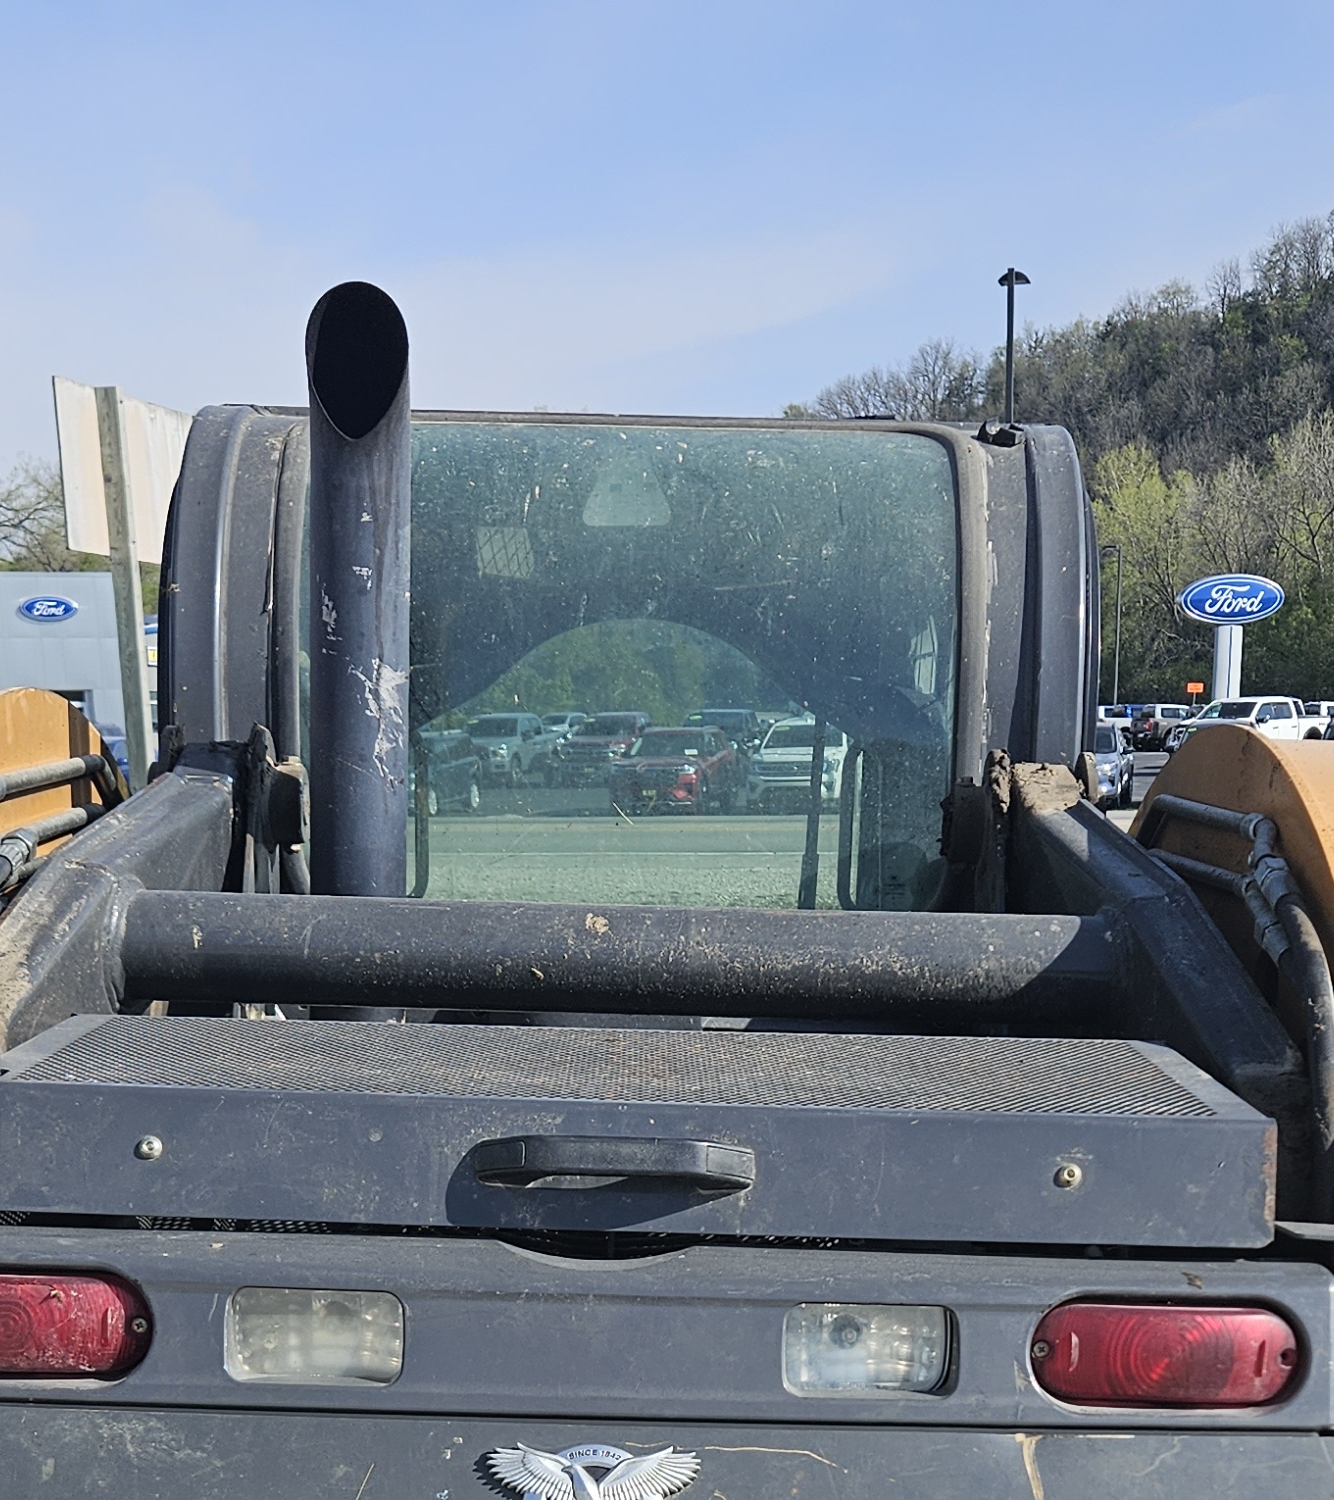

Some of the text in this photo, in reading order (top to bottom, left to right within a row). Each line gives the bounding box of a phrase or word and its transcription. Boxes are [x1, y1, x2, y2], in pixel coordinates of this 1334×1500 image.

[1204, 584, 1265, 614] Ford
[32, 600, 66, 616] Ford
[568, 1449, 622, 1461] SINCE 1842
